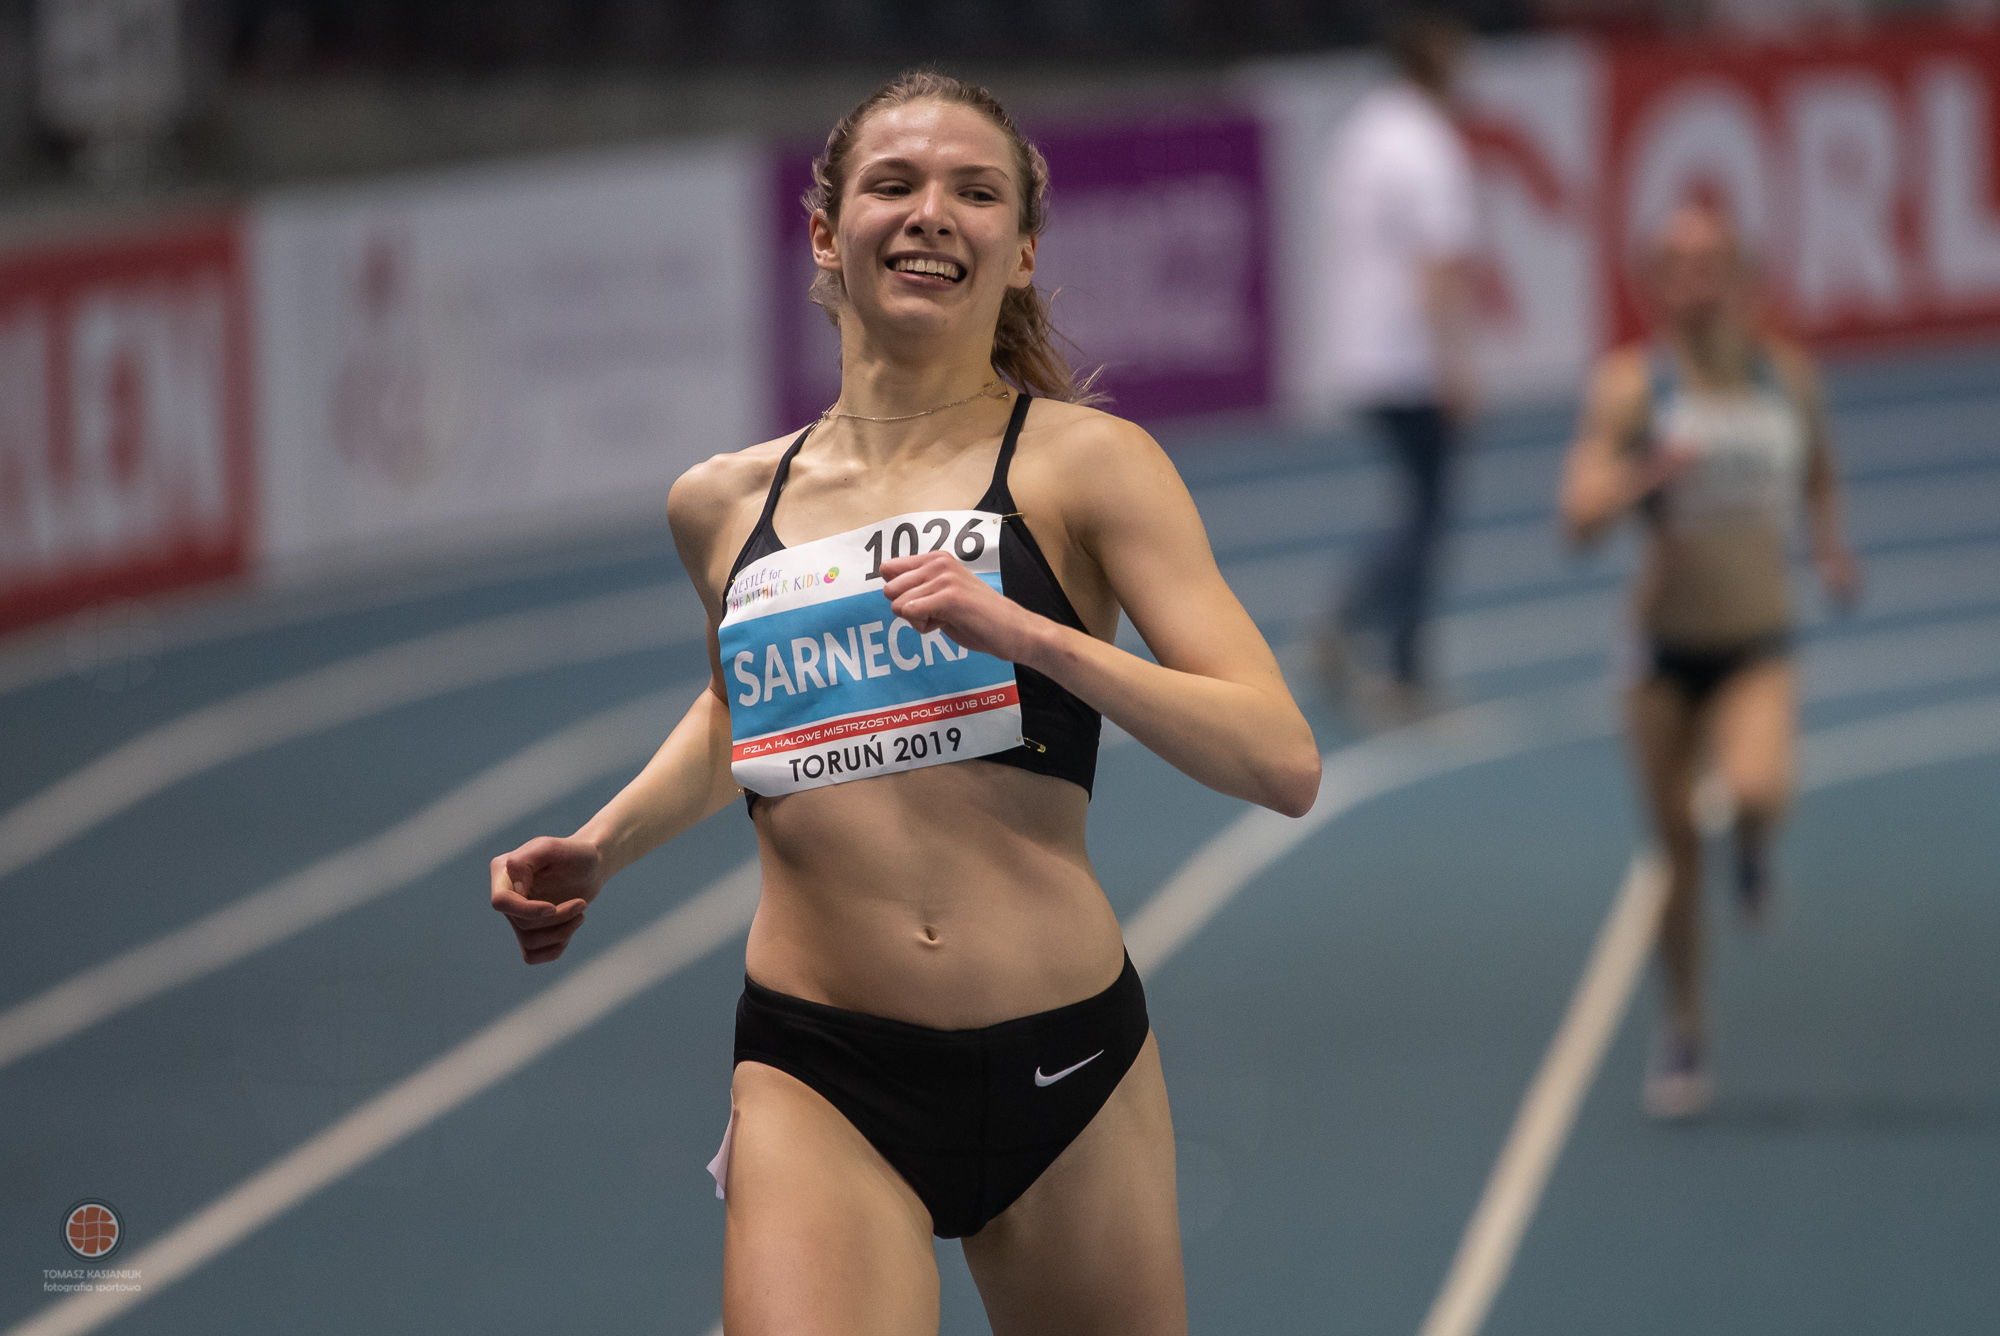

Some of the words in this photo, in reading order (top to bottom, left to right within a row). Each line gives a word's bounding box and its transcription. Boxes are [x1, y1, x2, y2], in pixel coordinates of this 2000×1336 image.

[864, 518, 985, 581] 1026
[732, 568, 767, 597] NESTLÉ
[769, 569, 782, 581] for
[794, 572, 820, 591] KIDS
[734, 617, 969, 706] SARNECK
[743, 742, 773, 756] PZLA
[775, 731, 822, 749] HALOWE
[823, 713, 909, 737] MISTRZOSTWA
[911, 705, 953, 720] POLSKI
[956, 699, 978, 712] U18
[981, 693, 1006, 707] U20
[789, 735, 884, 782] TORUŃ
[893, 727, 962, 764] 2019
